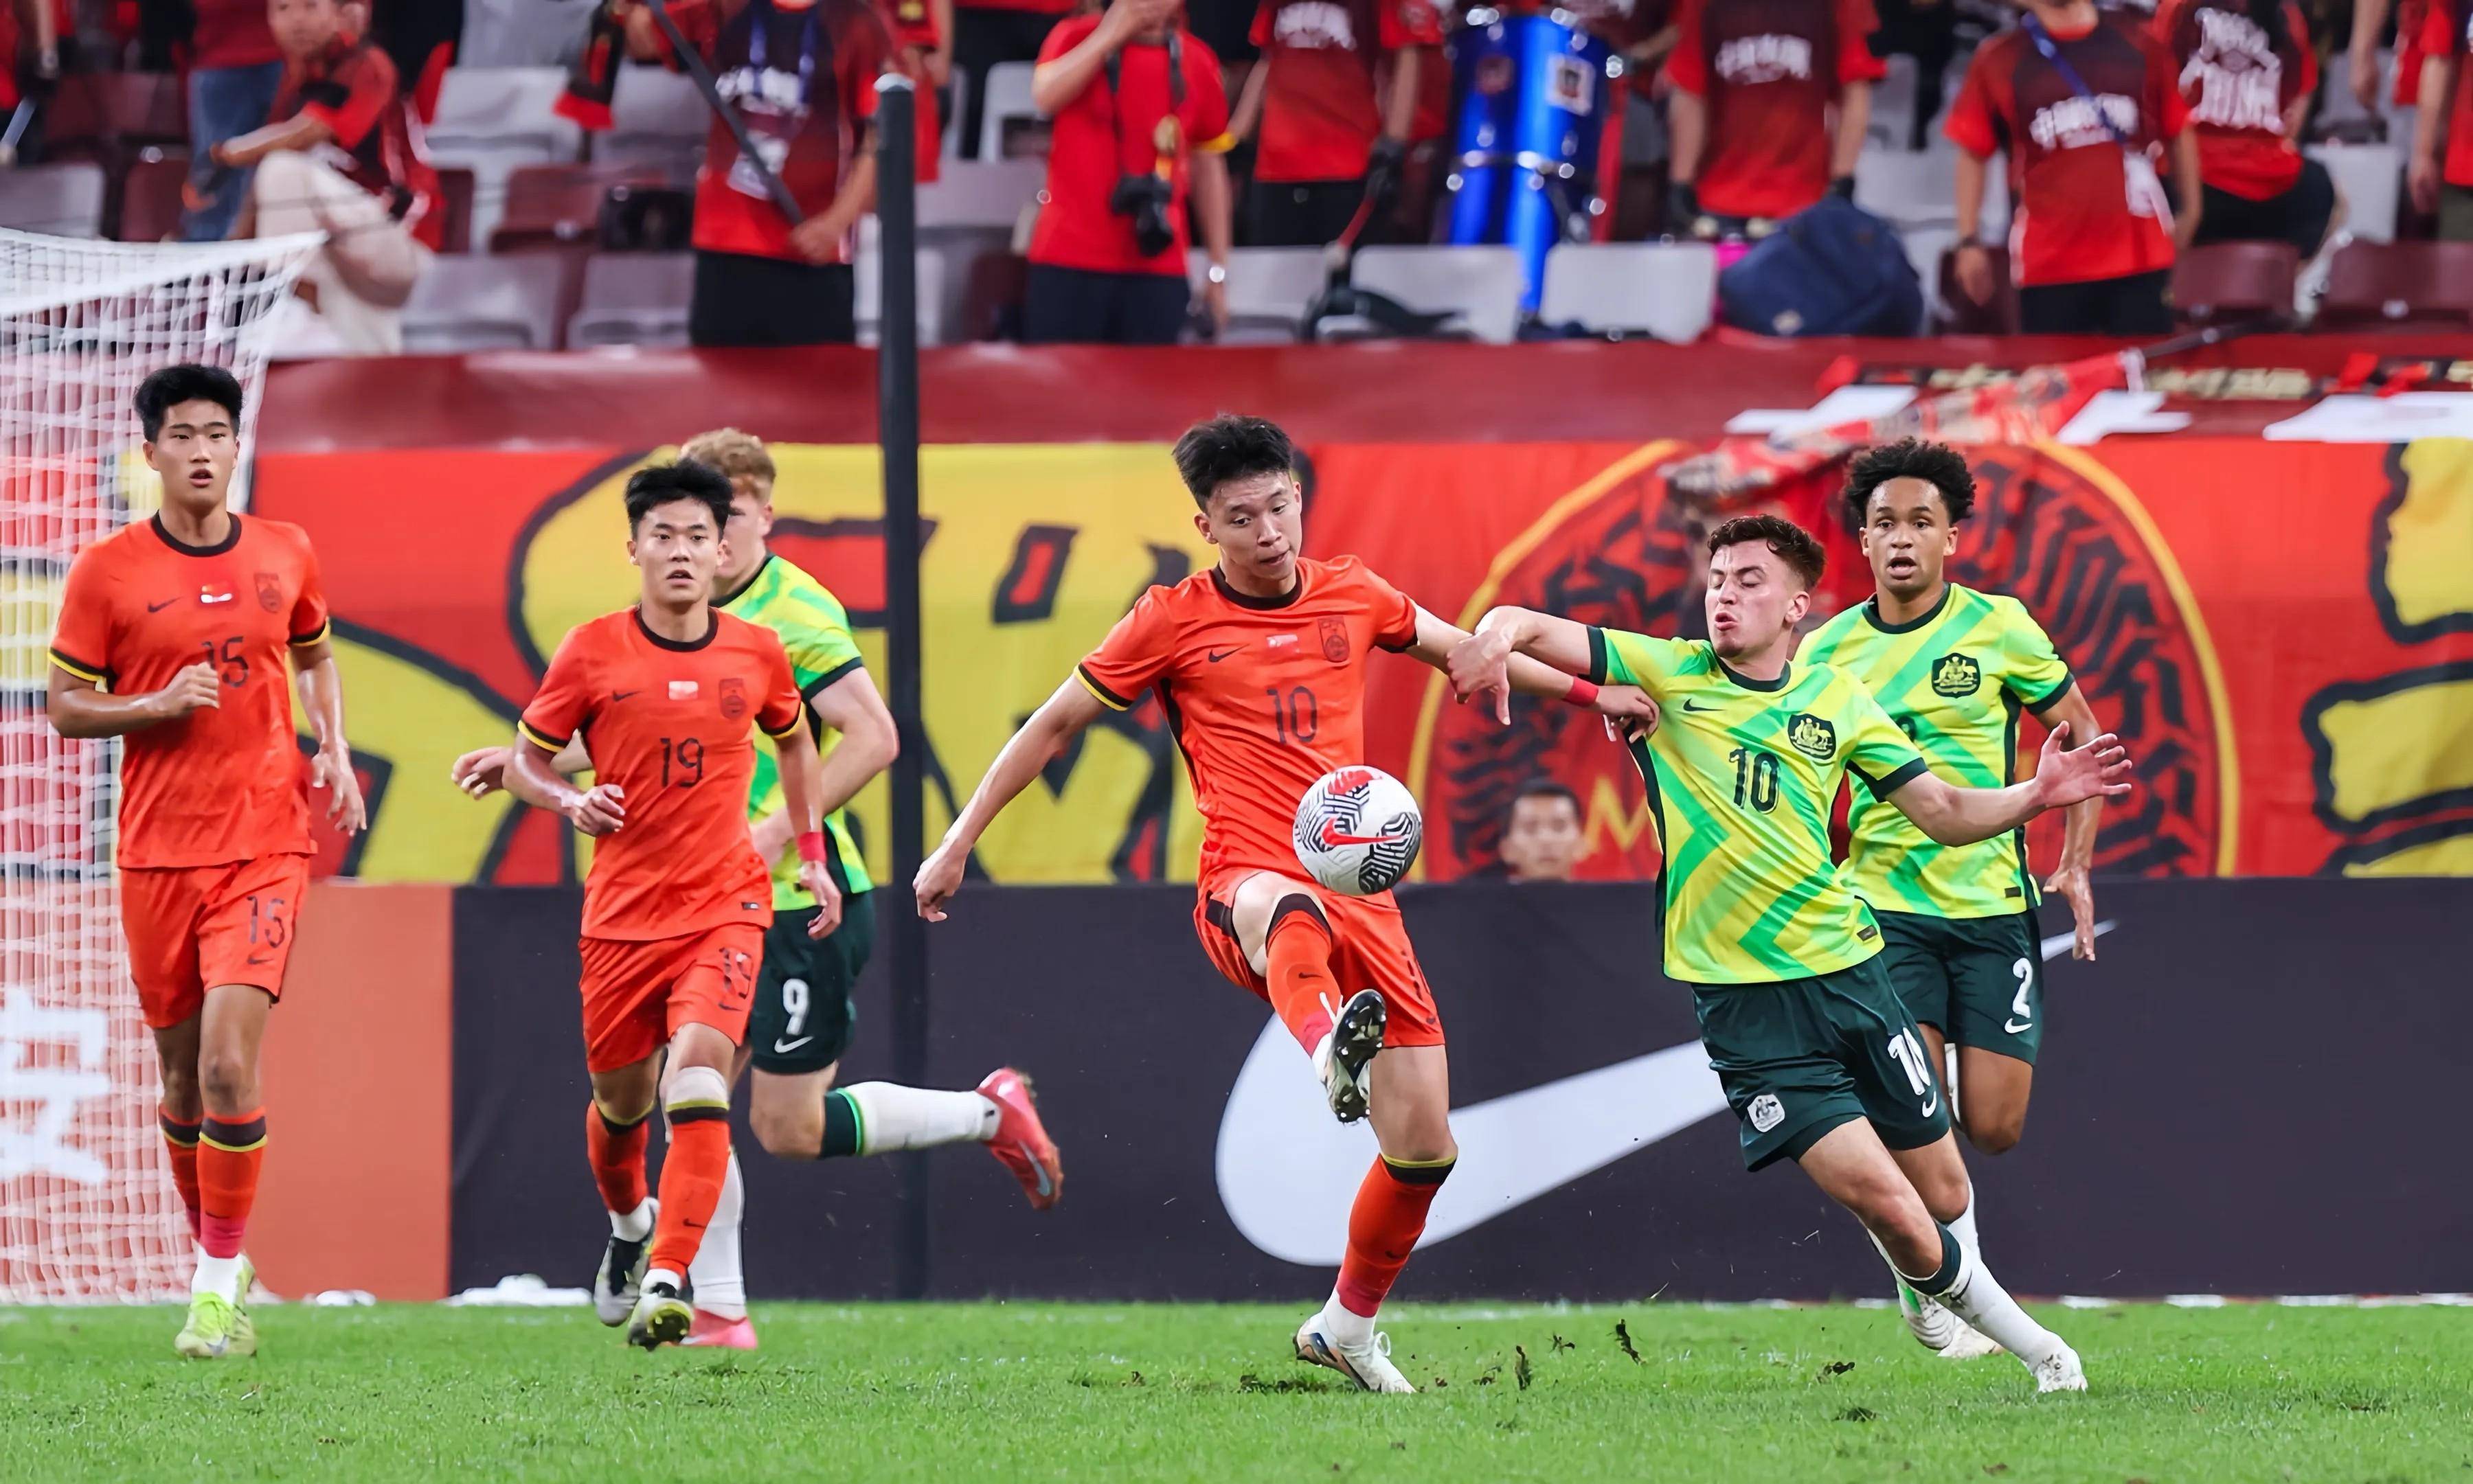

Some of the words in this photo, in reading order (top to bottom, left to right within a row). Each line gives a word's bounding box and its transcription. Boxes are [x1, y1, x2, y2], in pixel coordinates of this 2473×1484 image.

[201, 636, 249, 688] 15
[1266, 685, 1317, 746] 10
[659, 737, 703, 788] 19
[1728, 747, 1780, 814] 10
[247, 895, 285, 948] 15
[718, 947, 754, 1000] 19
[2012, 957, 2033, 1018] 2
[782, 978, 809, 1036] 9
